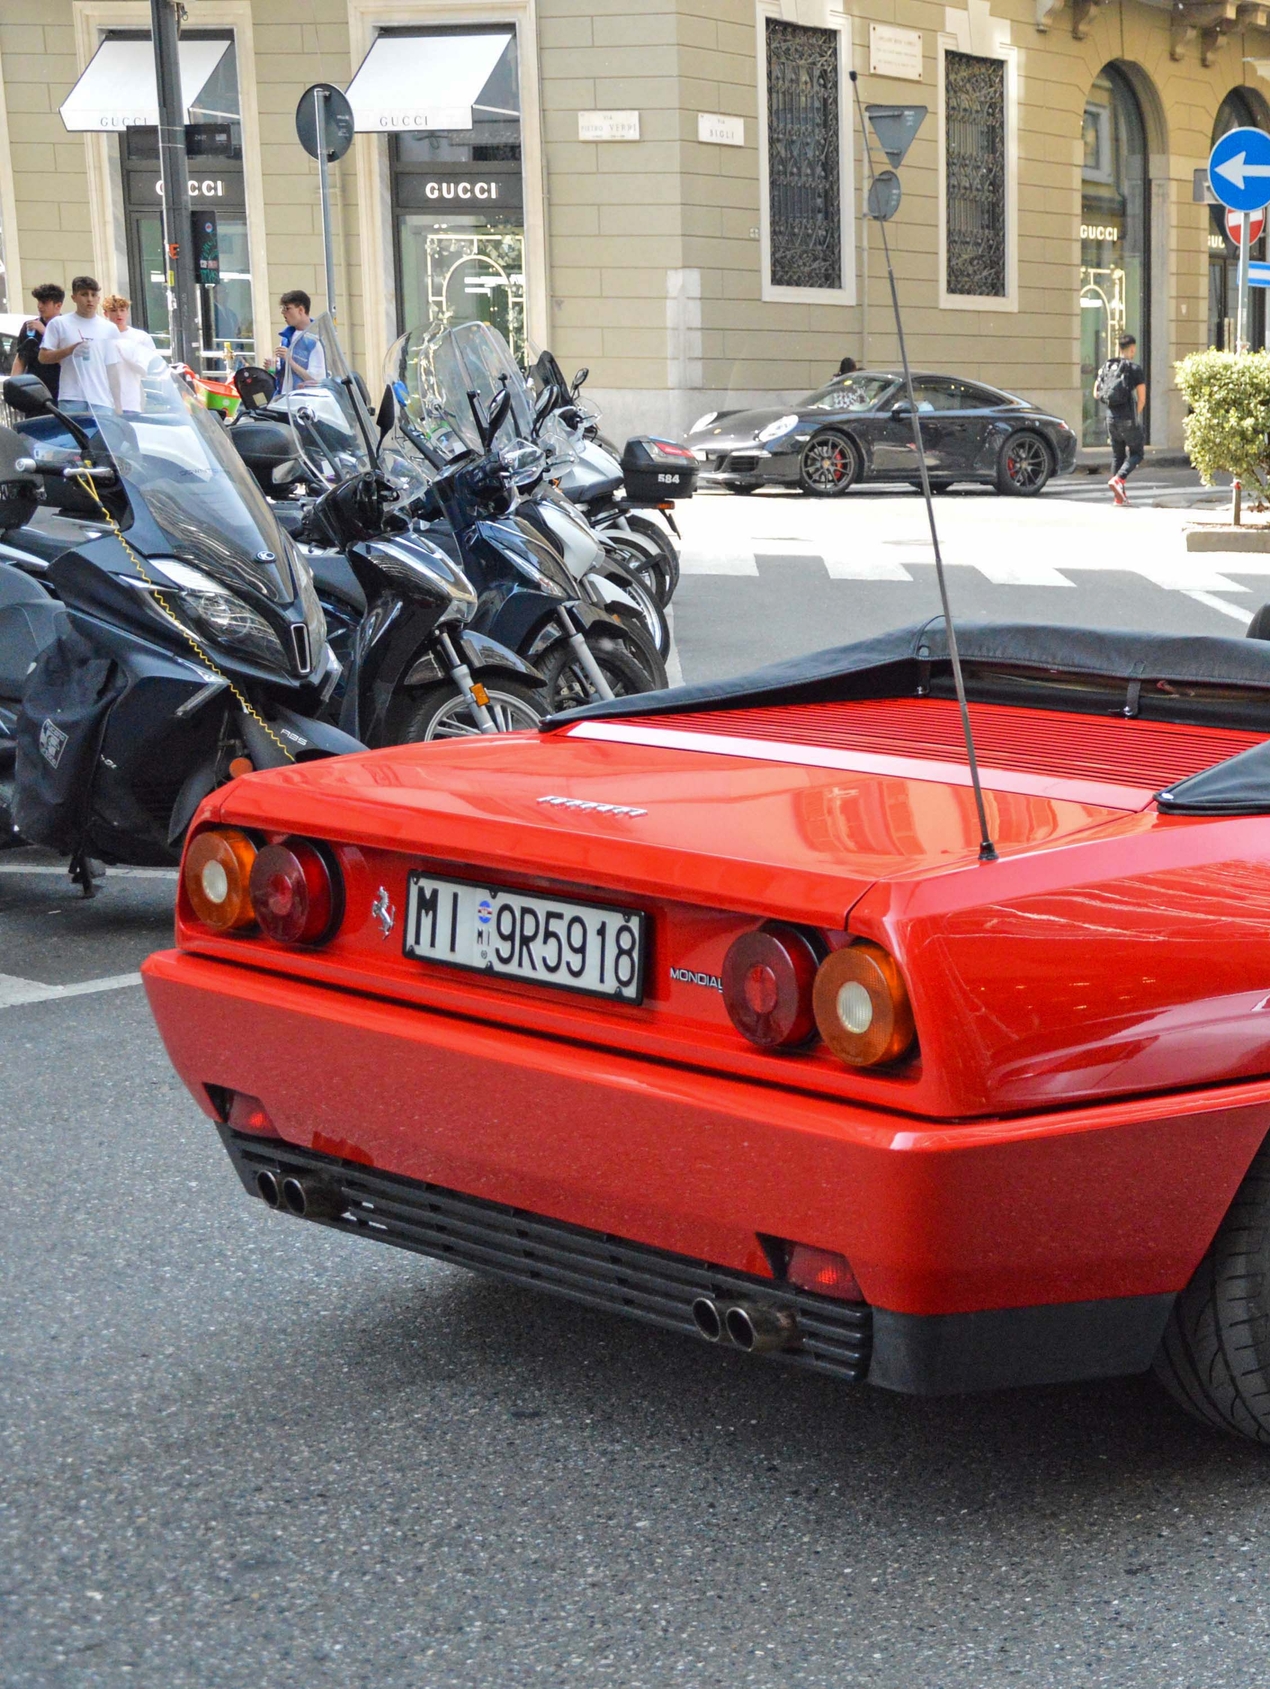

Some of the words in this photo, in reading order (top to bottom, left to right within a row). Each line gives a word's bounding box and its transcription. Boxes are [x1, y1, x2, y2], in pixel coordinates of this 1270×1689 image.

[100, 117, 148, 127] GUCCI
[379, 115, 429, 127] GUCCI
[709, 129, 735, 140] BIGLI
[155, 180, 223, 197] GCCI
[425, 182, 497, 199] GUCCI
[1080, 224, 1118, 242] GUCCI
[657, 473, 680, 484] 584
[280, 728, 308, 746] ABS
[494, 903, 637, 988] 9R5918
